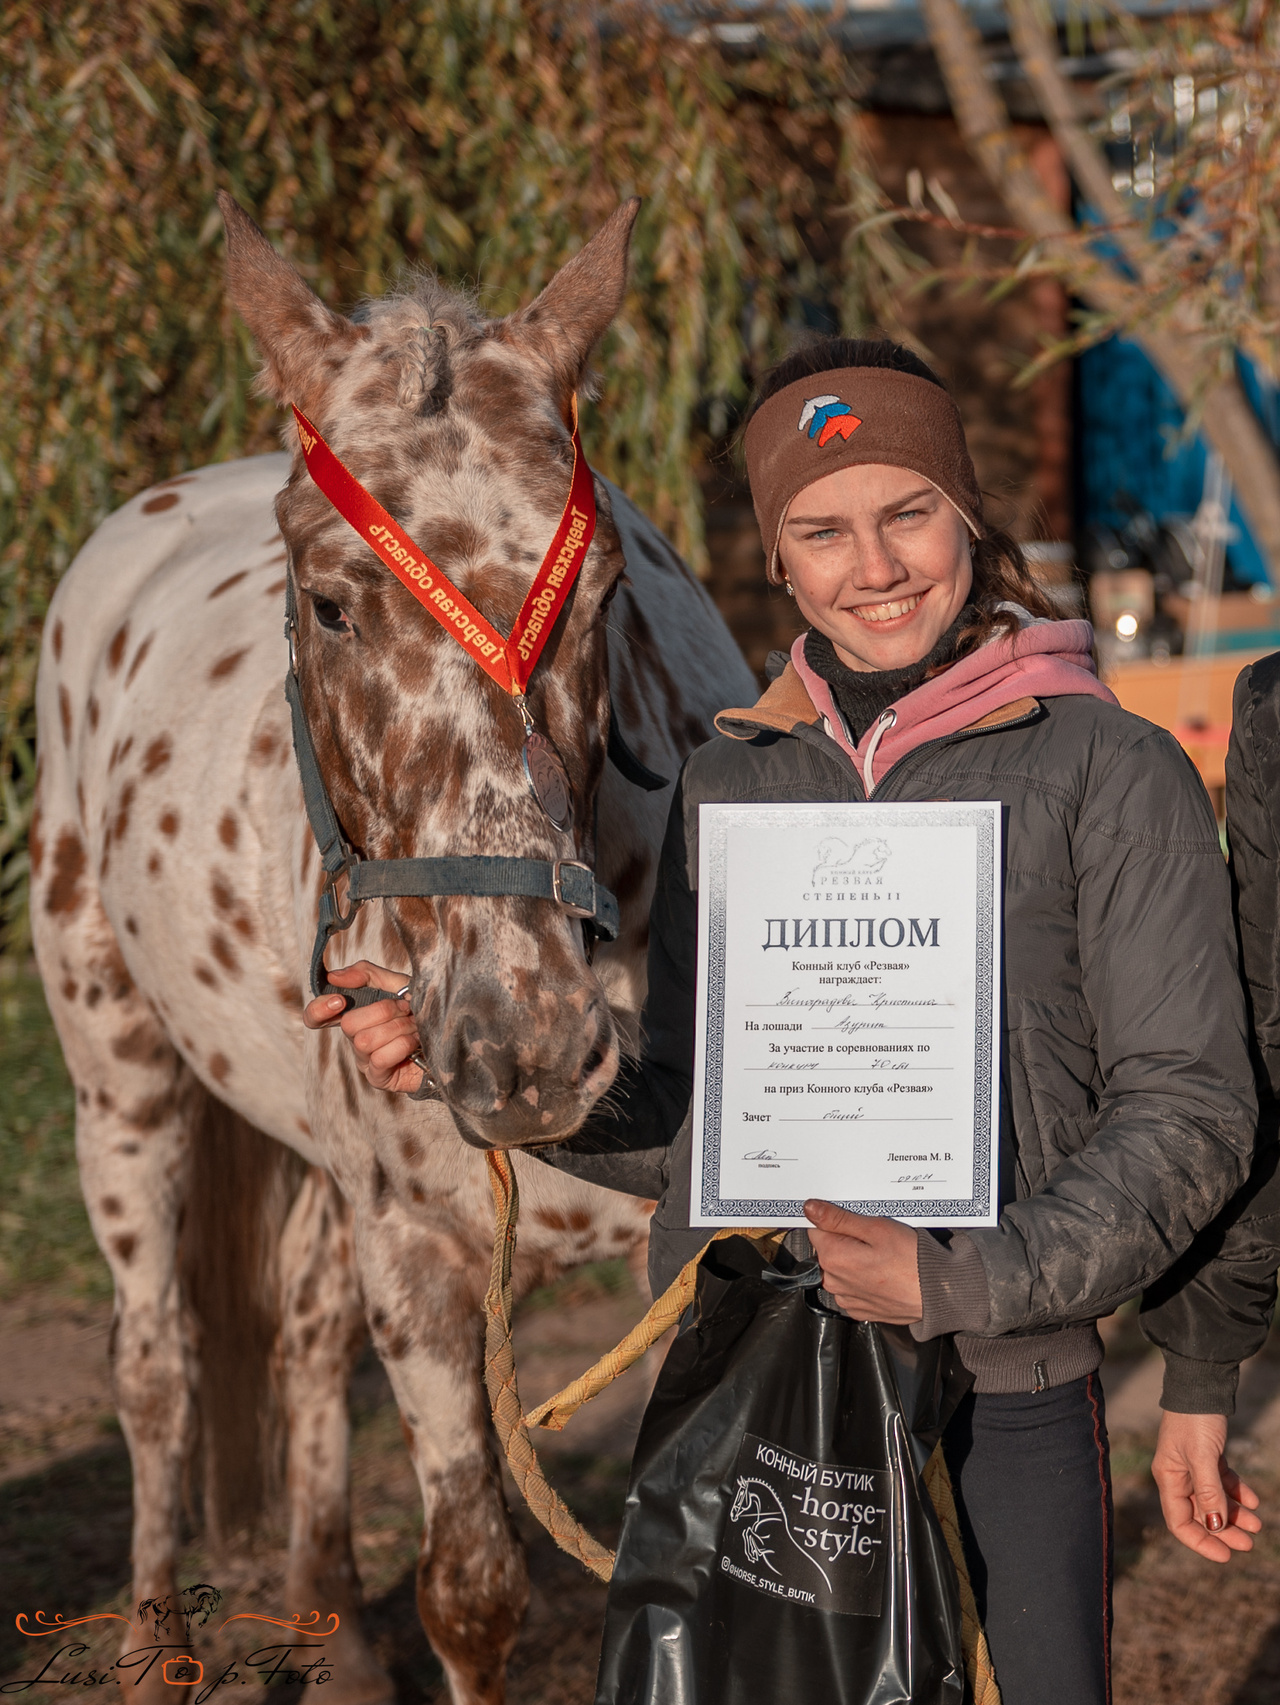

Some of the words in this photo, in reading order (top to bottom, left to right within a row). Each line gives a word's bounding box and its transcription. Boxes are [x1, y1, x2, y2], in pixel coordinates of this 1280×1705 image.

[820, 876, 883, 886] РЕЗВАЯ
[802, 892, 881, 901] СТЕПЕНЬ
[761, 917, 941, 952] ДИПЛОМ
[791, 960, 834, 971] Конный
[836, 960, 861, 974] клуб
[863, 961, 911, 971] «Резвая»
[818, 975, 882, 987] награждает:
[744, 1021, 762, 1031] На
[763, 1022, 803, 1032] лошади
[768, 1043, 781, 1053] За
[783, 1044, 825, 1055] участие
[827, 1045, 834, 1053] в
[836, 1044, 914, 1055] соревнованиях
[916, 1044, 930, 1053] по
[764, 1086, 777, 1094] на
[779, 1086, 804, 1096] приз
[806, 1084, 851, 1094] Конного
[853, 1083, 884, 1096] клуба
[886, 1083, 934, 1094] «Резвая»
[742, 1112, 772, 1122] Зачет
[930, 1152, 942, 1161] М.
[944, 1152, 954, 1161] В.
[756, 1443, 818, 1485] КОННЫЙ
[820, 1470, 874, 1492] БУТИК
[792, 1486, 887, 1525] -horse-
[793, 1525, 882, 1562] -style-
